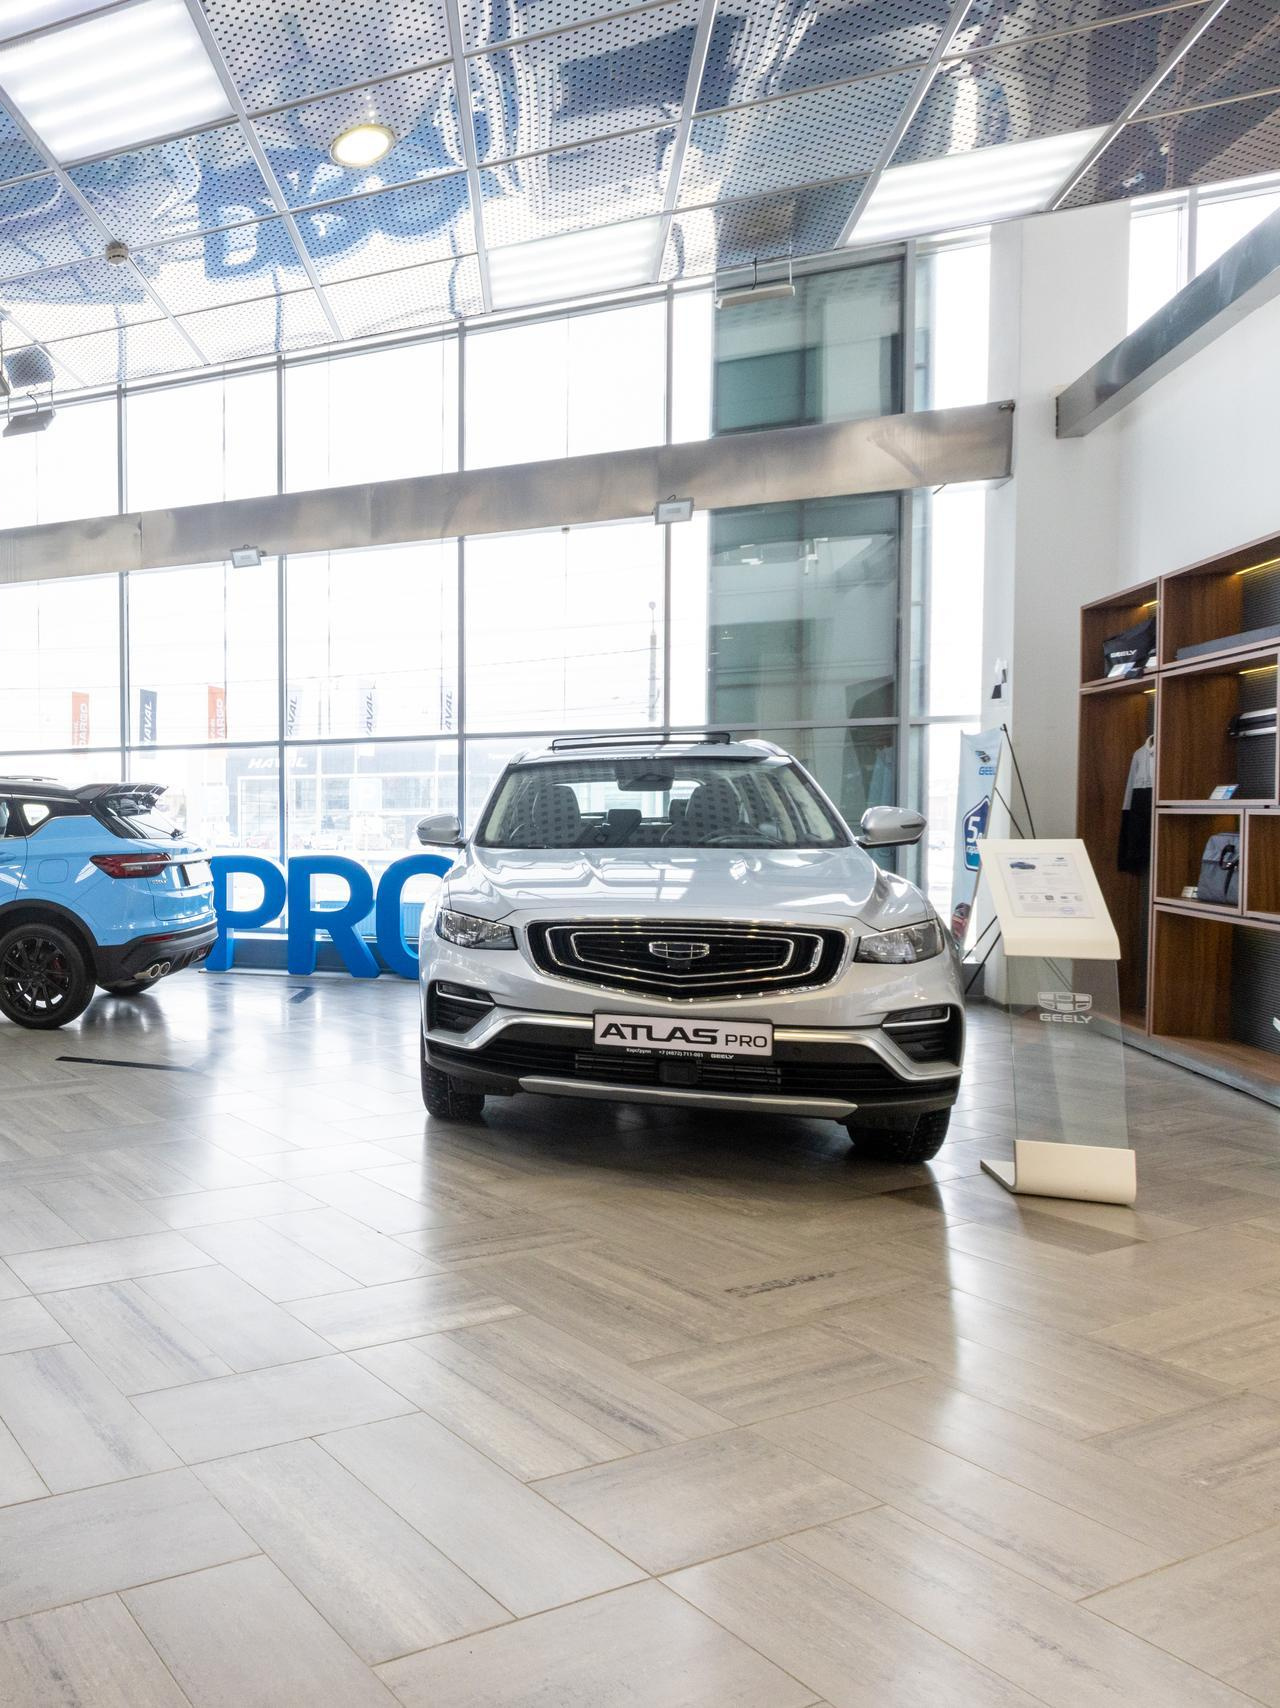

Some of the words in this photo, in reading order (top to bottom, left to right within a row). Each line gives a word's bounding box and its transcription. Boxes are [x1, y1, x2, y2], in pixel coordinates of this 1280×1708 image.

[216, 698, 224, 737] ARGO
[365, 691, 374, 737] AVAL
[444, 690, 453, 730] AVAL
[978, 766, 996, 776] GEEL
[1040, 1013, 1093, 1024] GEELY
[600, 1022, 720, 1045] ATLAS
[725, 1034, 768, 1048] PRO
